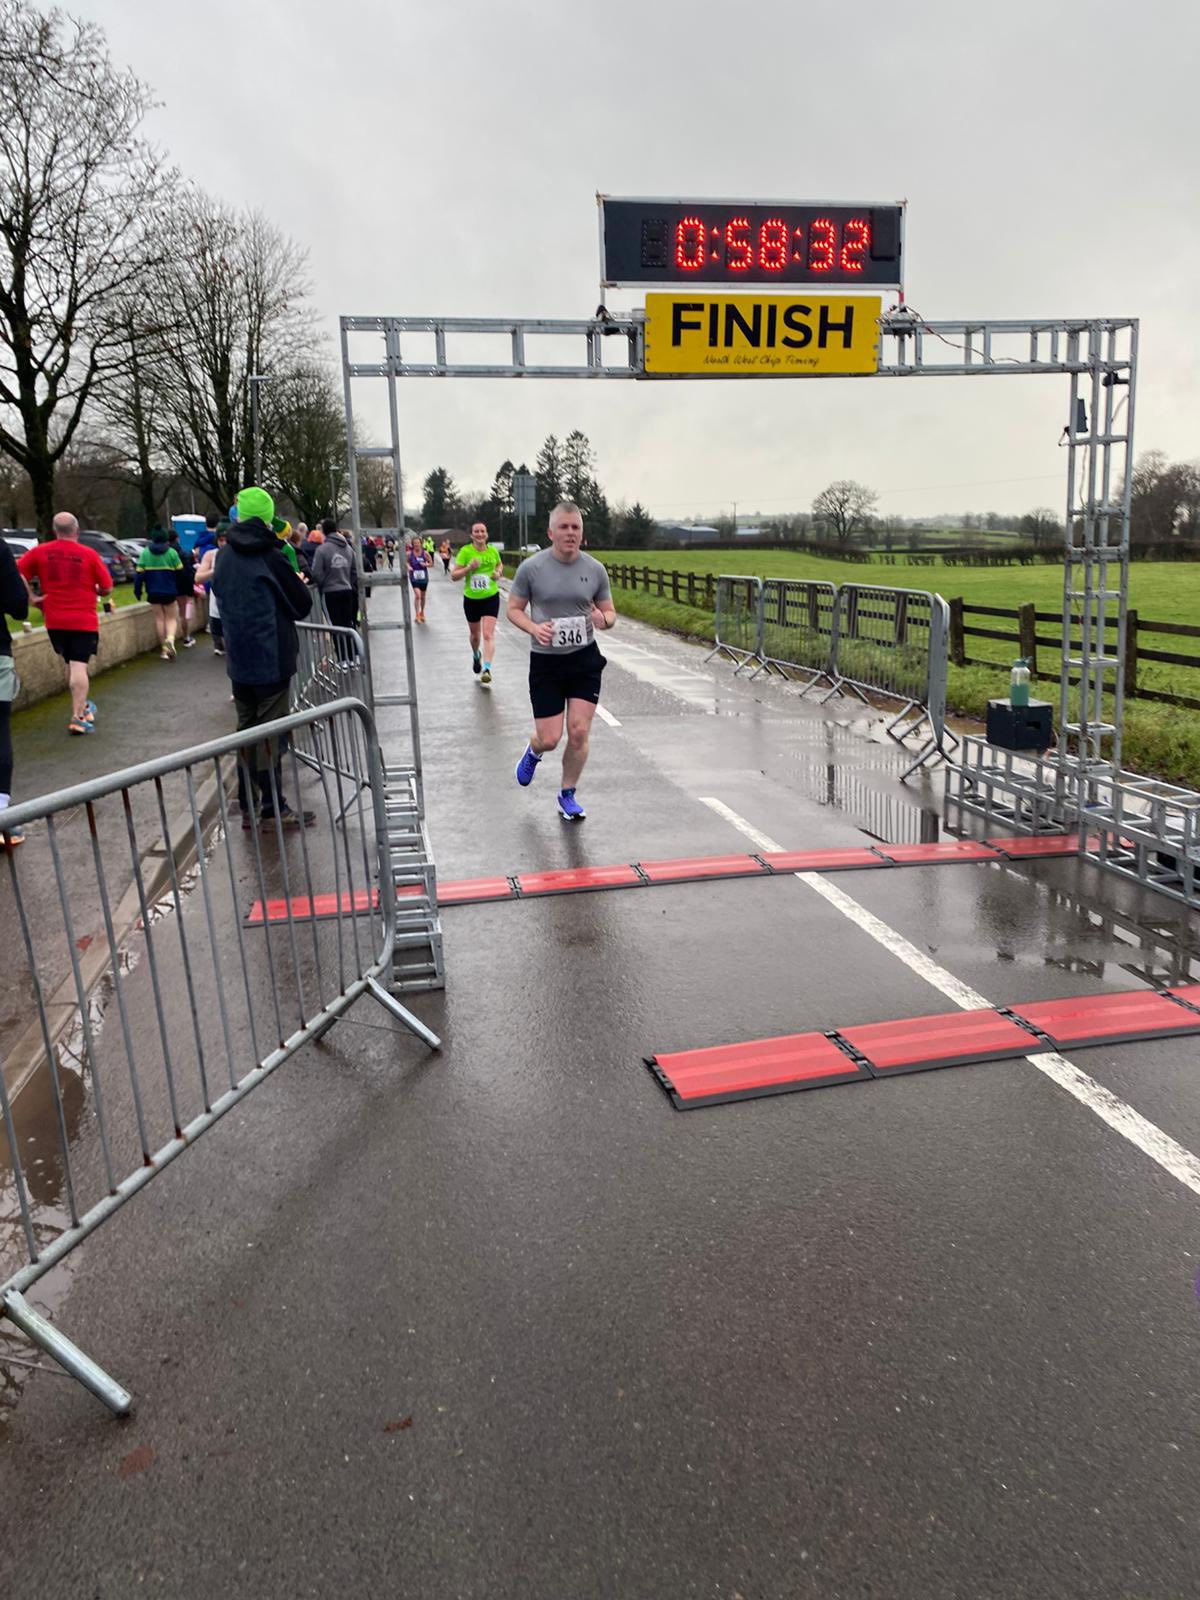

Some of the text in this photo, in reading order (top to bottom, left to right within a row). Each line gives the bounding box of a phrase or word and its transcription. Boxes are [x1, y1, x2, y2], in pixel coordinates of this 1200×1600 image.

[676, 216, 870, 271] 0:58:32
[672, 302, 855, 349] FINISH
[759, 354, 782, 368] Chip
[785, 354, 820, 368] Timing
[558, 629, 583, 645] 346
